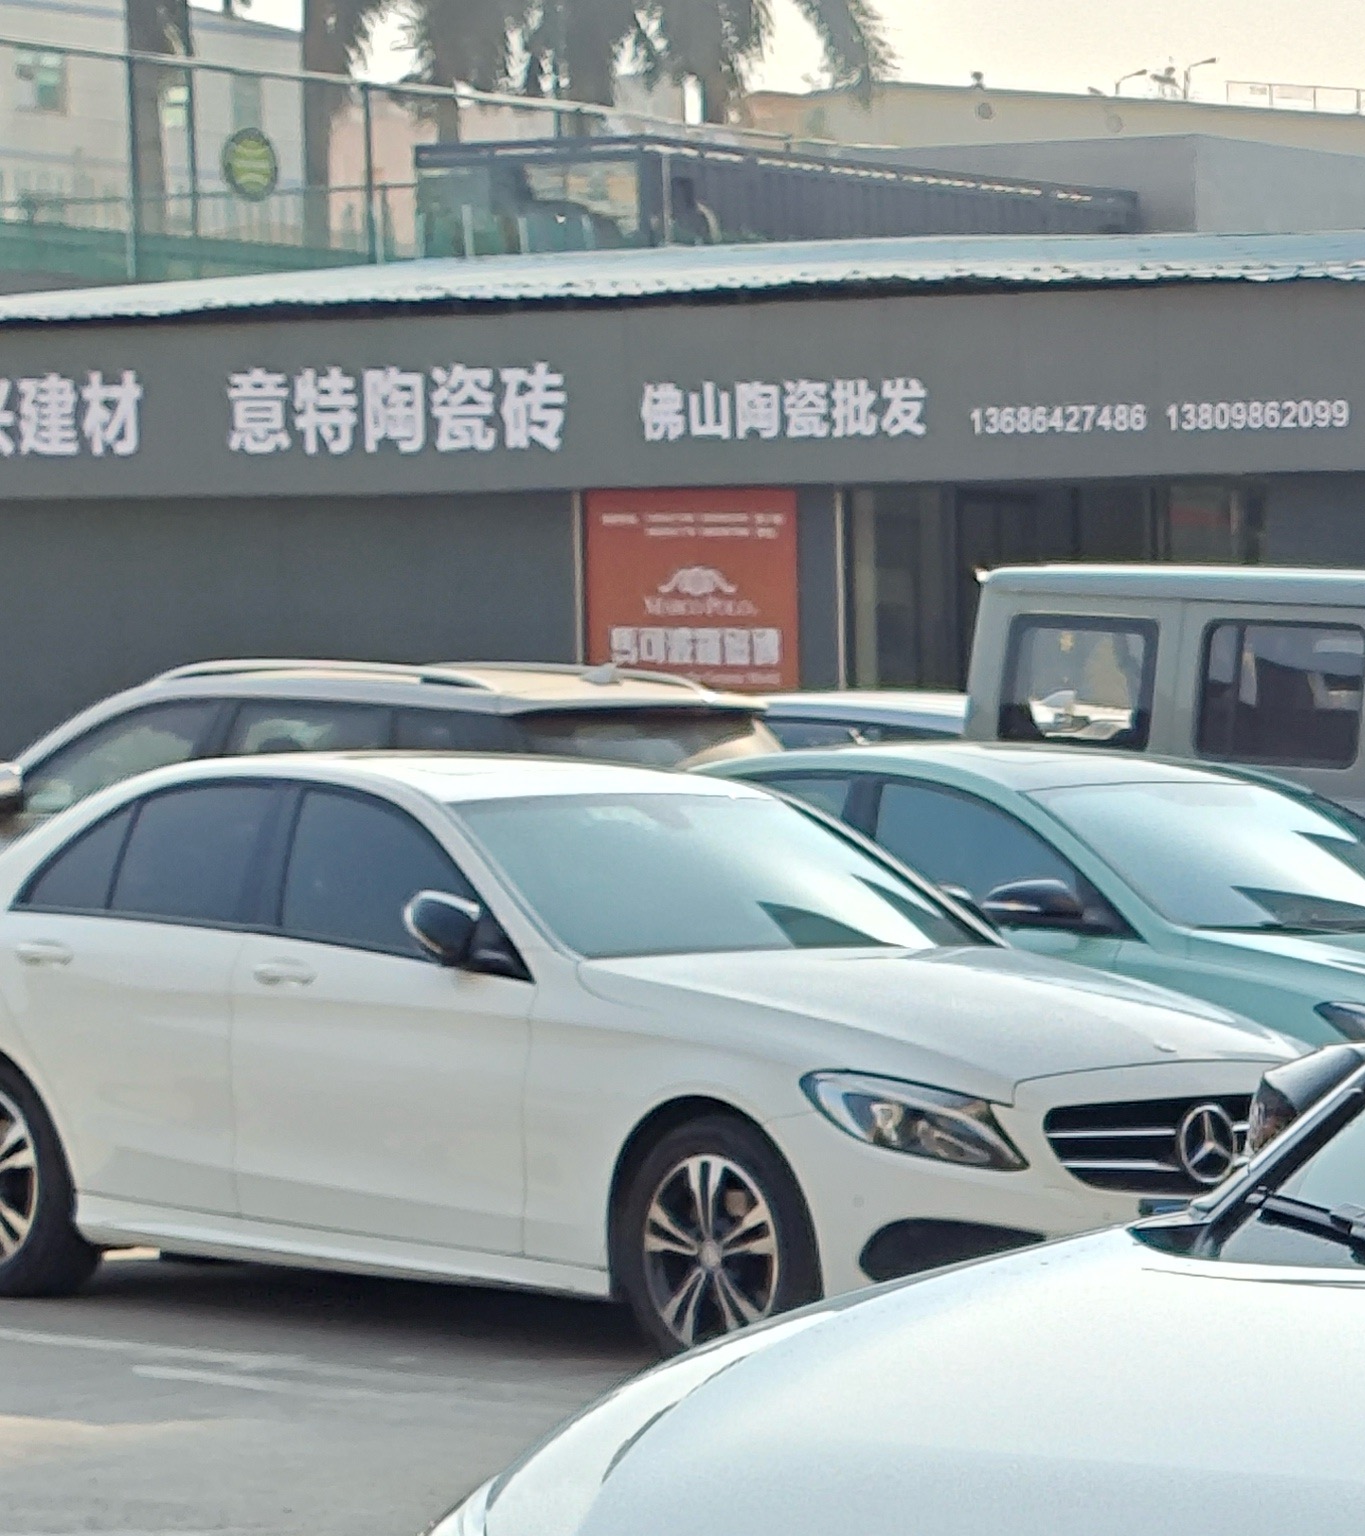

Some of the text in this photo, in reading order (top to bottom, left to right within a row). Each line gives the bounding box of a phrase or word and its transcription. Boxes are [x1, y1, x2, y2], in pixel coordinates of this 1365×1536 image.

[0, 362, 1349, 457] 建材 意特陶瓷砖 佛山陶瓷批发 13686427486 13809862099
